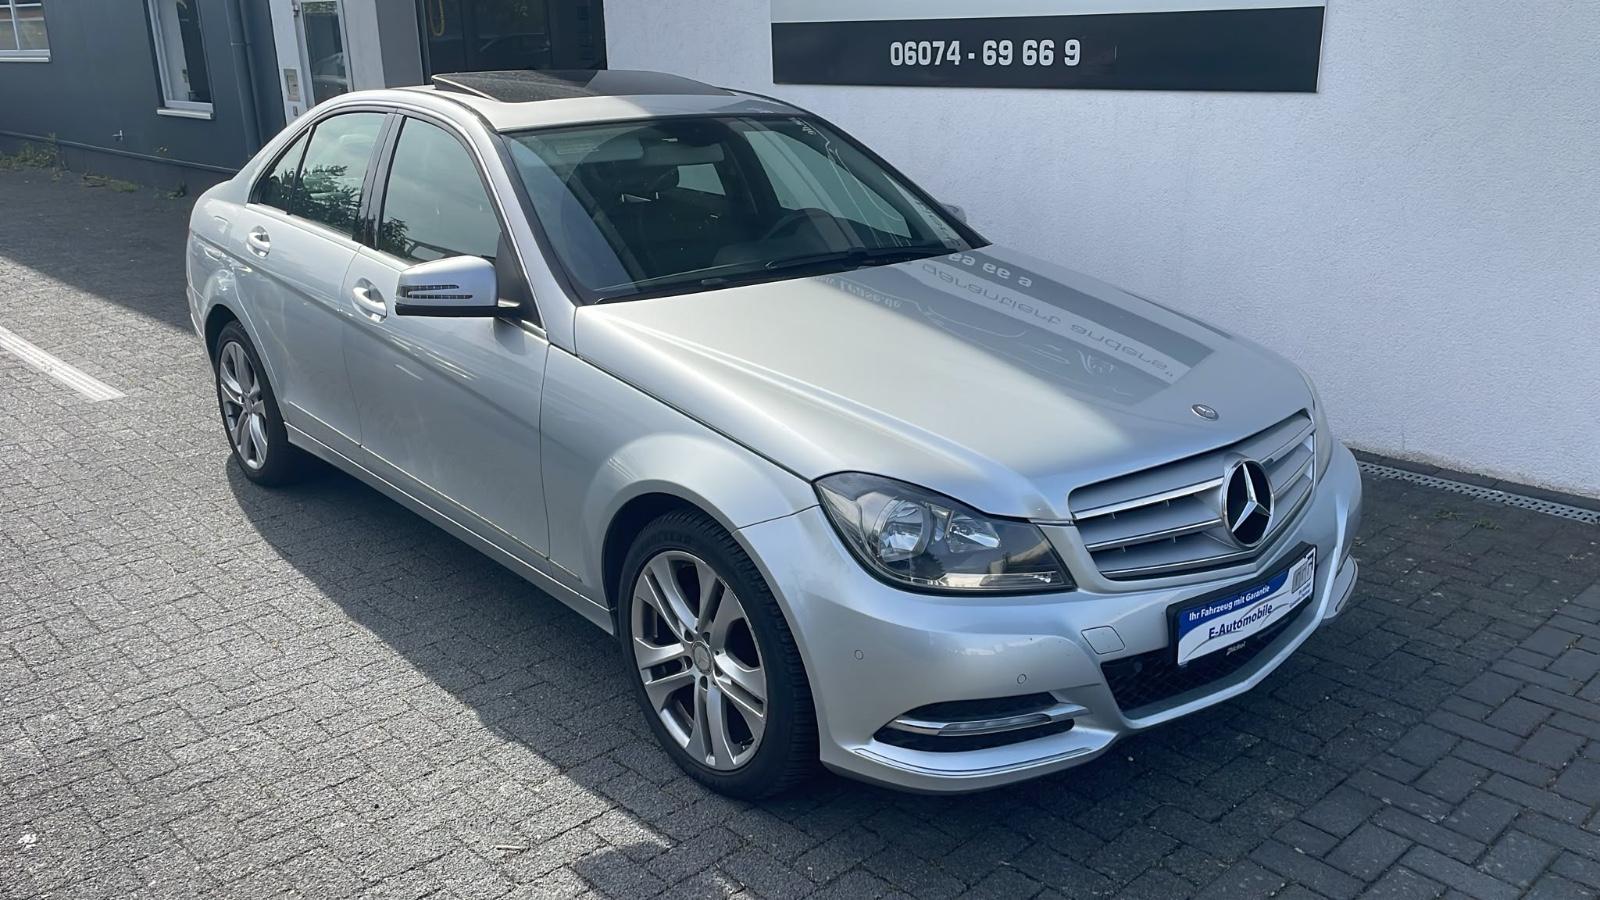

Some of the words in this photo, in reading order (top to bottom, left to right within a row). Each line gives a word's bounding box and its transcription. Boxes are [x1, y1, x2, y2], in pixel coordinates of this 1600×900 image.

[889, 40, 961, 66] 06074
[982, 39, 1013, 66] 69
[1022, 39, 1055, 66] 66
[1064, 39, 1081, 66] 9
[1188, 611, 1201, 621] Ihr
[1200, 601, 1233, 617] Fahrzeug
[1233, 595, 1246, 606] mit
[1245, 585, 1271, 601] Garantie
[1208, 603, 1273, 639] E-Automobile
